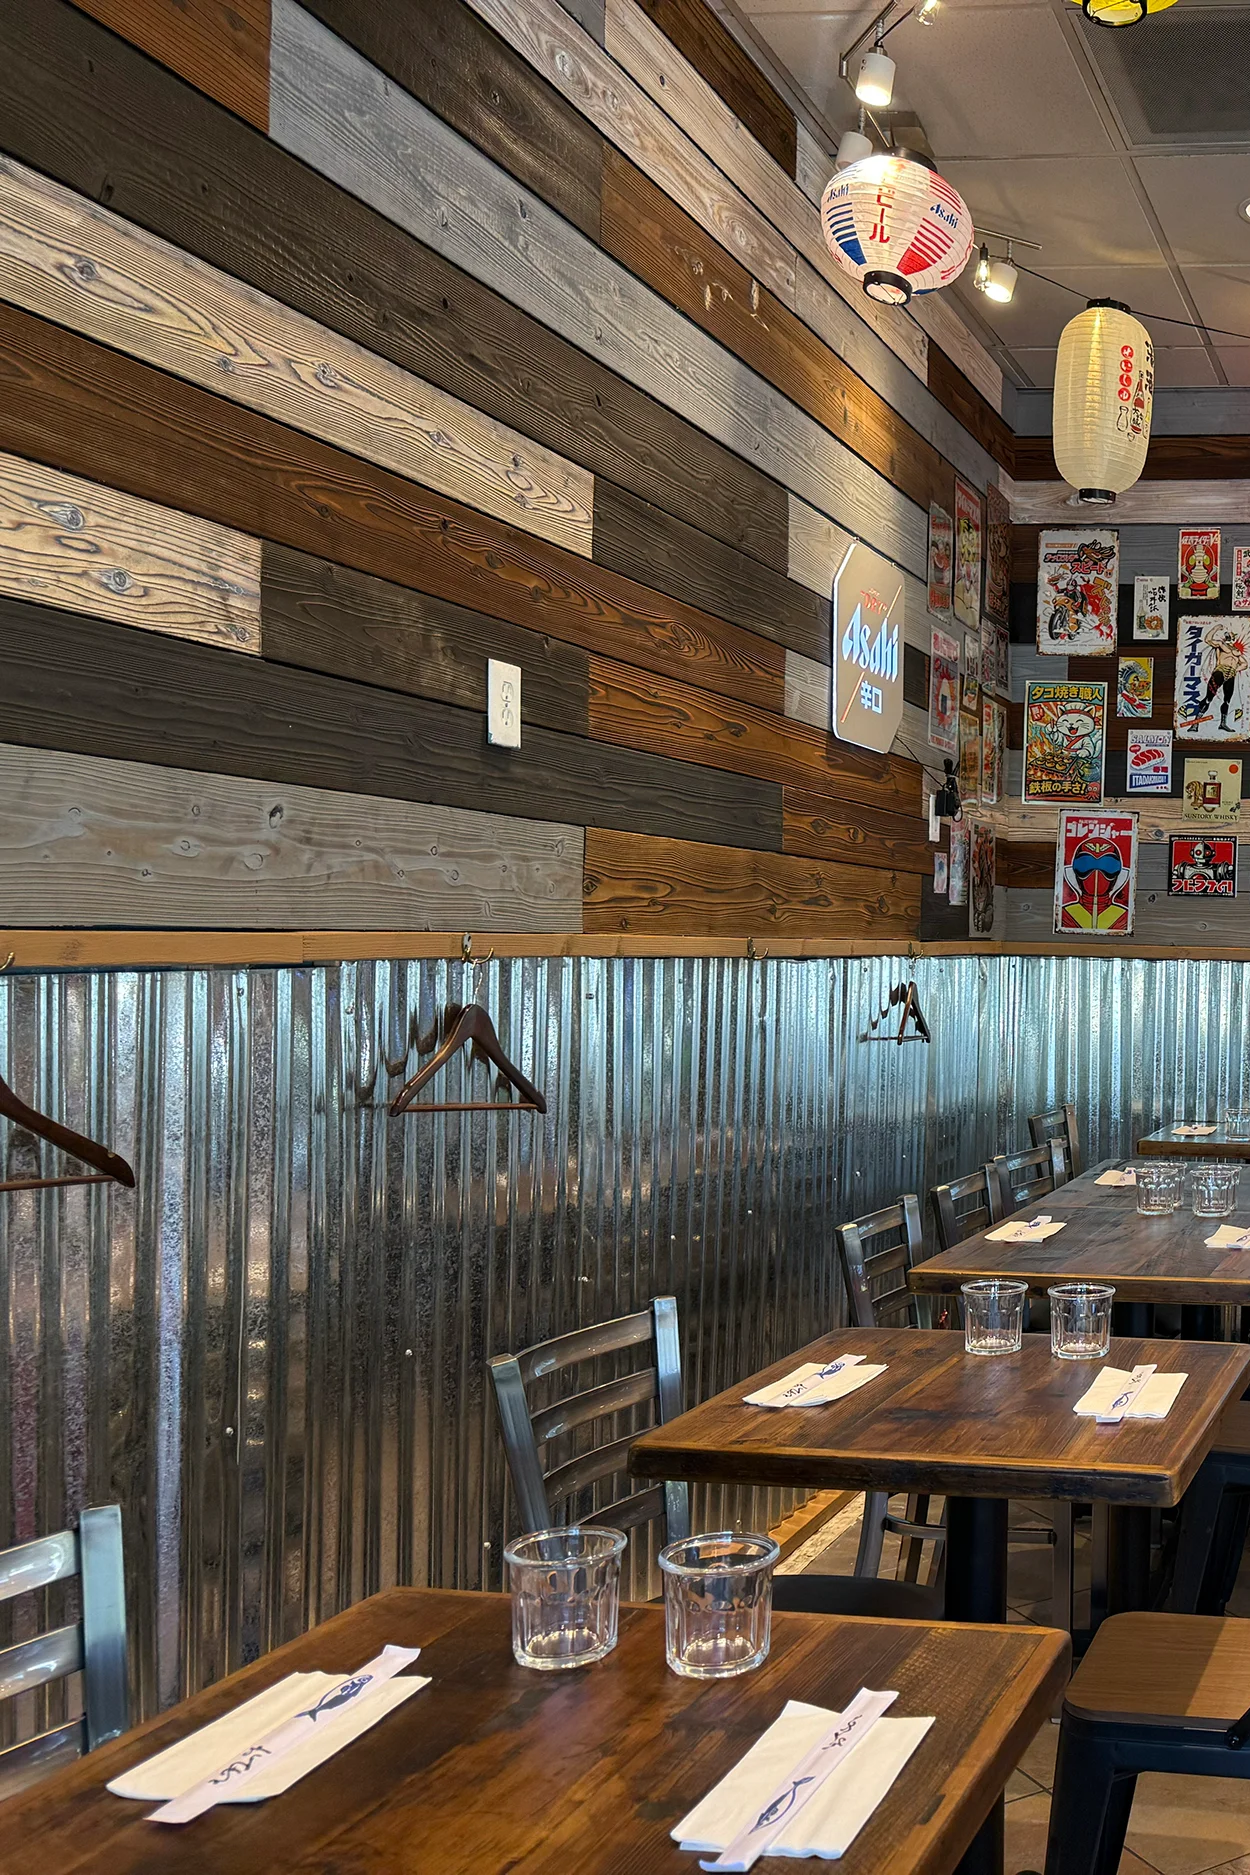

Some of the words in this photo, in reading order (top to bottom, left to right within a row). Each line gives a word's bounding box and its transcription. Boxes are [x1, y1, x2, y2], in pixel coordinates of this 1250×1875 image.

[929, 203, 959, 229] Asahi
[842, 602, 899, 683] Asahi
[860, 680, 883, 714] 辛口
[1031, 685, 1103, 701] タコ焼き職人
[1184, 813, 1213, 821] SUNTORY
[1214, 813, 1238, 821] WHISKY
